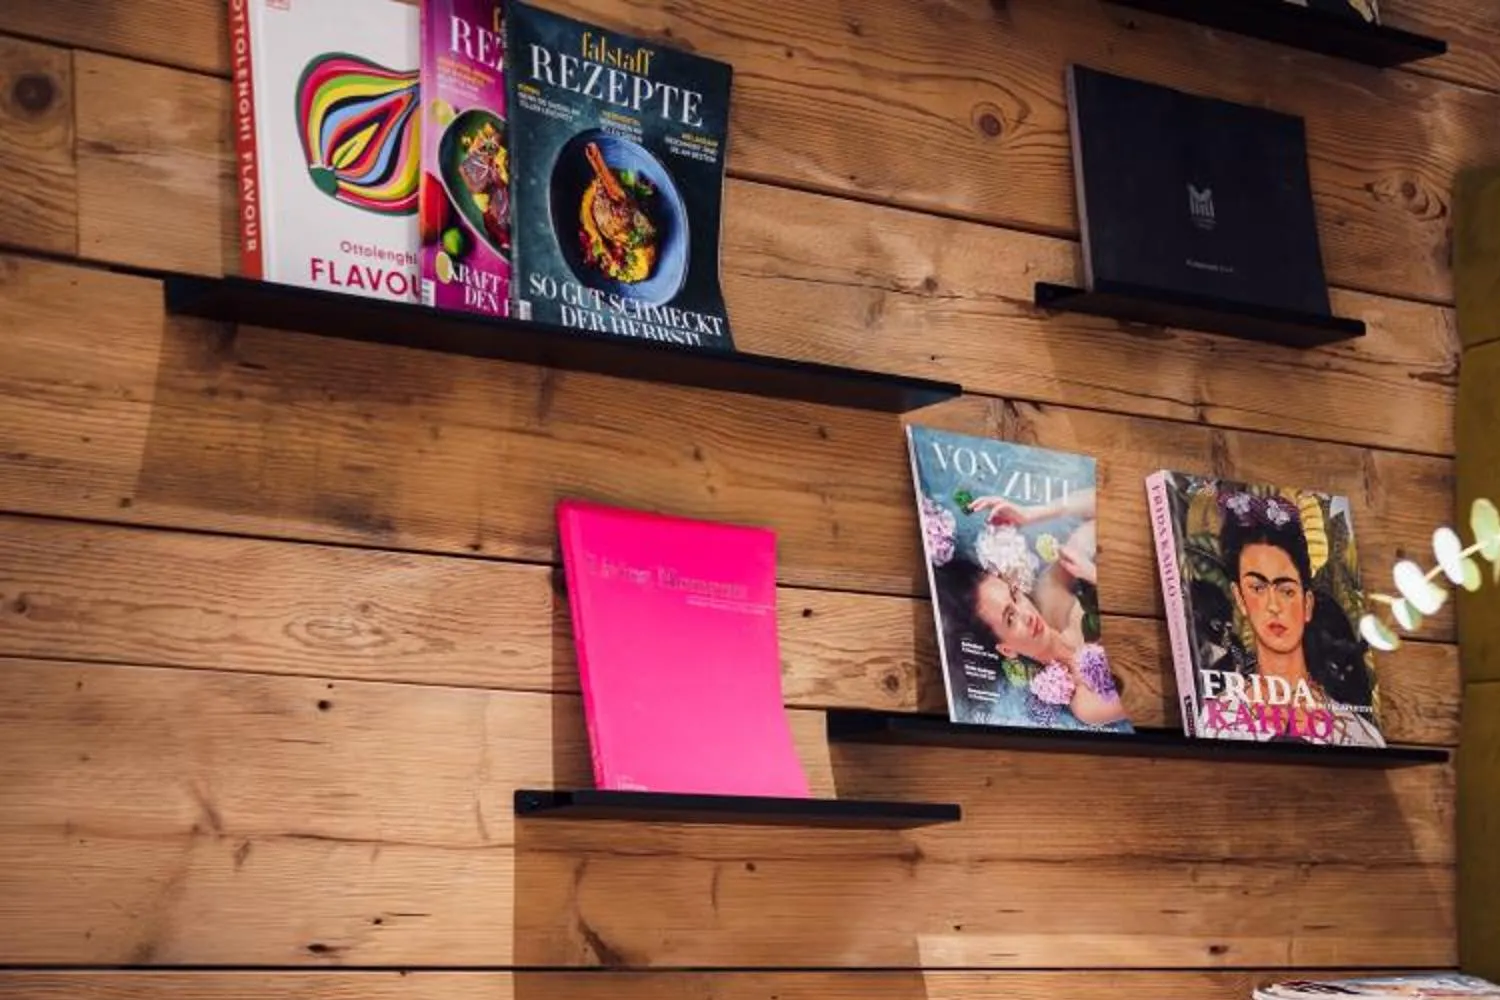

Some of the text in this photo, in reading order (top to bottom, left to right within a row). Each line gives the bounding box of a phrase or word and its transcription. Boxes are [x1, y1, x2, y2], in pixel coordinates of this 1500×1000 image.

[581, 31, 655, 76] falstaff
[530, 43, 703, 127] REZEPTE
[232, 0, 257, 253] OTTOLENGHI FLAVOUR
[340, 241, 418, 266] Ottolenghi
[529, 272, 723, 337] SO GUT SCHMECKT
[560, 303, 608, 333] DER
[932, 442, 1002, 477] VON
[1152, 485, 1177, 597] FRIDA KAHLO
[1200, 669, 1316, 708] FRIDA
[1204, 700, 1333, 739] KAHLO
